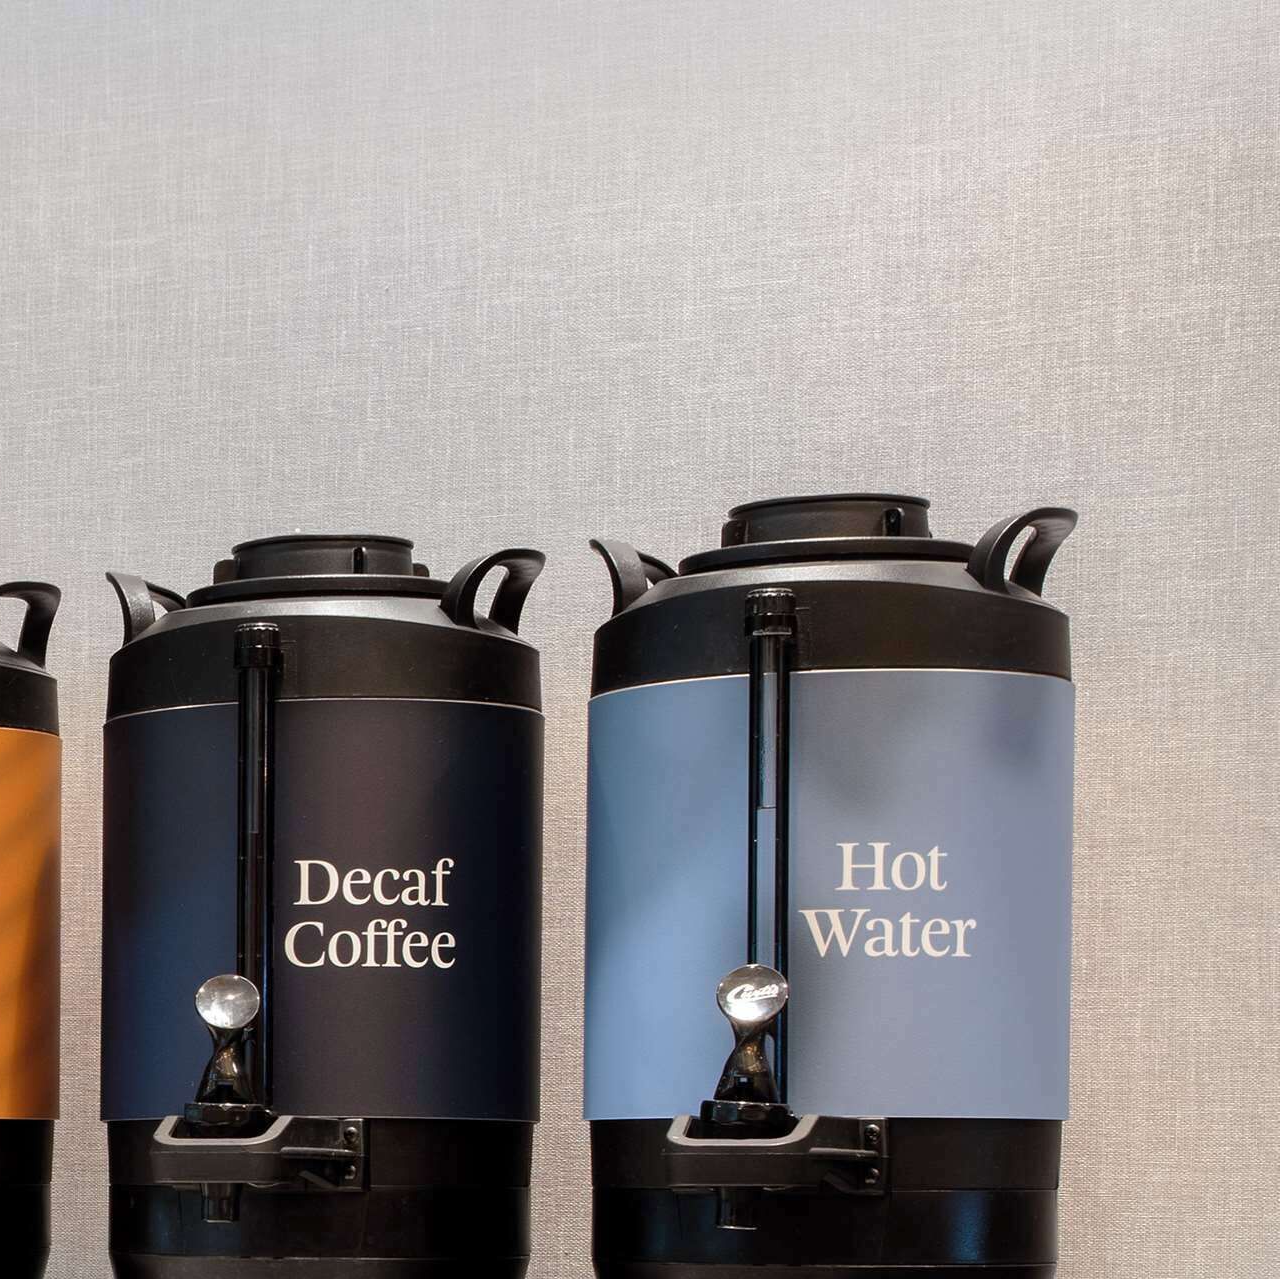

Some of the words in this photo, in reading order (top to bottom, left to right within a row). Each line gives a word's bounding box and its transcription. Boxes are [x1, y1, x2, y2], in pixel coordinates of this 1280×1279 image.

[293, 857, 455, 907] Decaf
[834, 841, 949, 892] Hot
[283, 919, 457, 969] Coffee
[798, 908, 977, 959] Water
